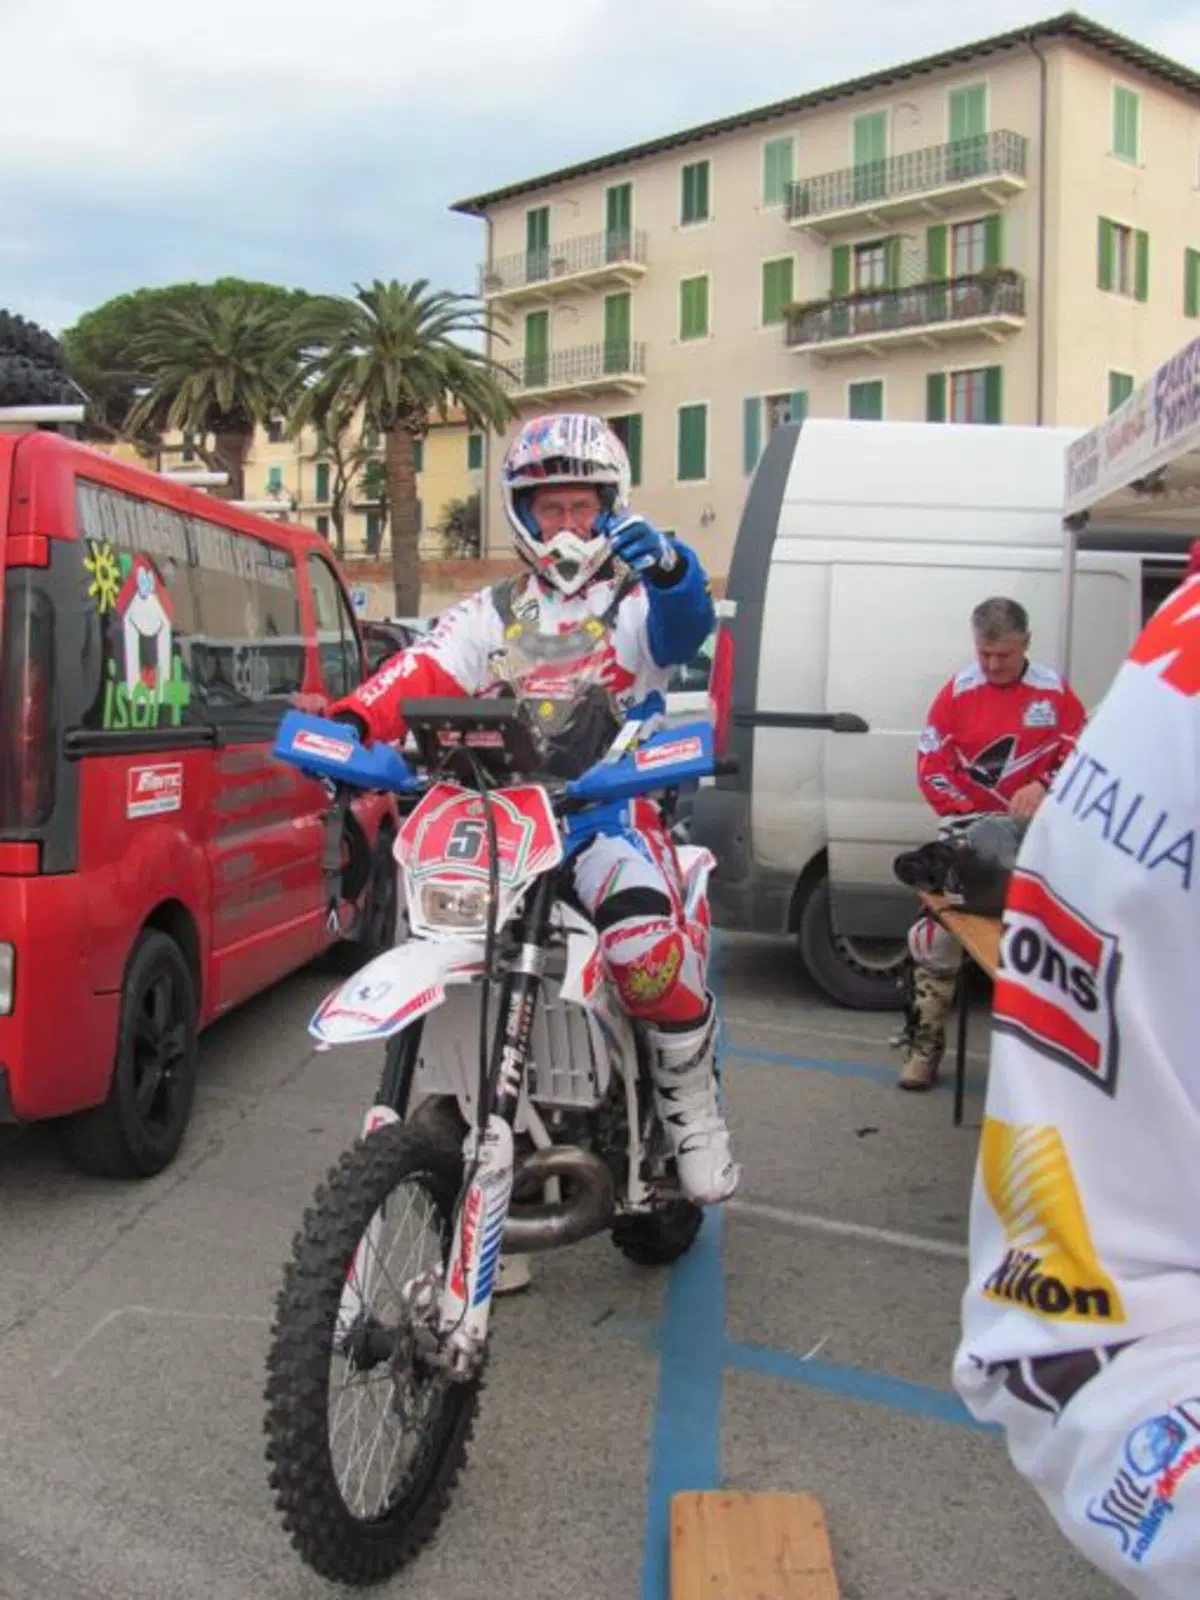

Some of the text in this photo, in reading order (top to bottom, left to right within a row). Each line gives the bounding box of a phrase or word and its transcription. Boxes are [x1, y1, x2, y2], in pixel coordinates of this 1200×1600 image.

[446, 818, 487, 861] 5
[1056, 752, 1195, 893] ITALIA
[1000, 923, 1099, 1013] ons
[983, 1248, 1111, 1317] Nikon
